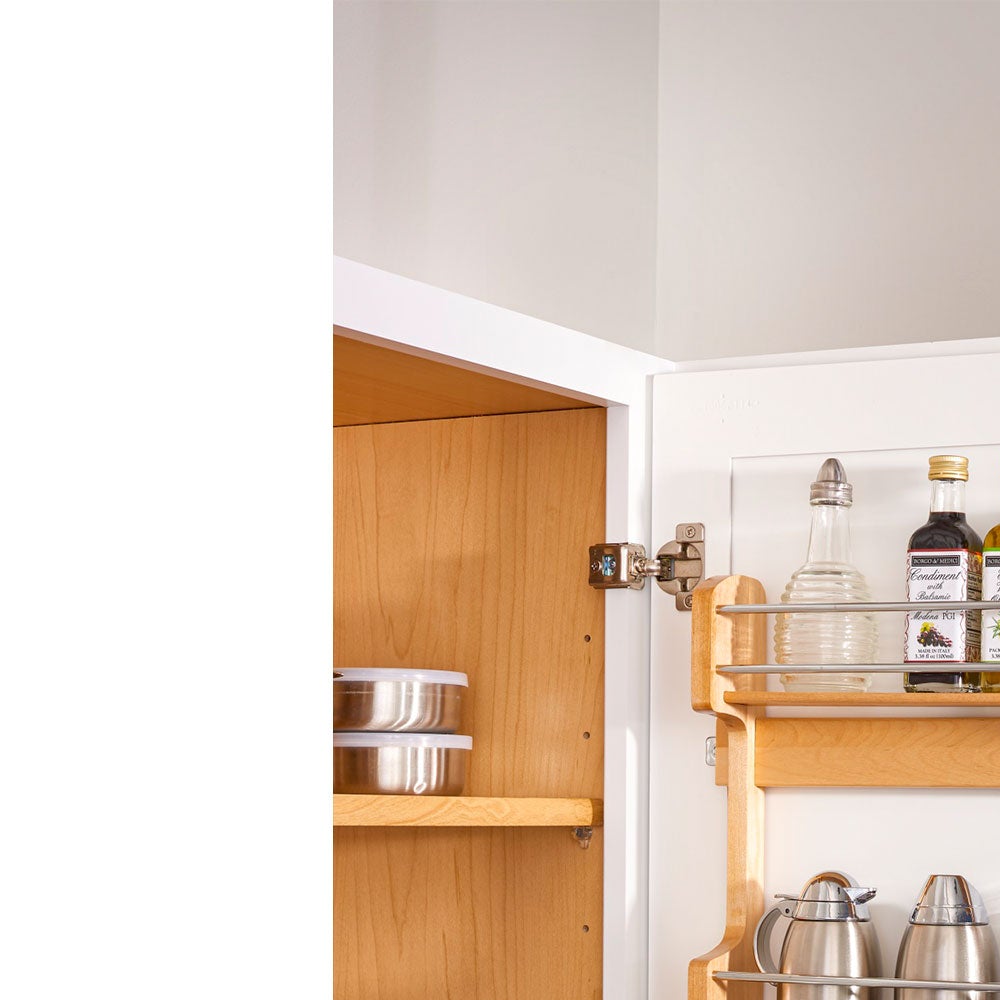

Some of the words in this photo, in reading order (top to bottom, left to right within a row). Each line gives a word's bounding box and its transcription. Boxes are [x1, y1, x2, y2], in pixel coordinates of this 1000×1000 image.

[910, 568, 961, 581] Condiment
[926, 582, 943, 590] with
[915, 592, 951, 600] Balsamic
[910, 610, 939, 620] Modena
[942, 611, 956, 620] PGI
